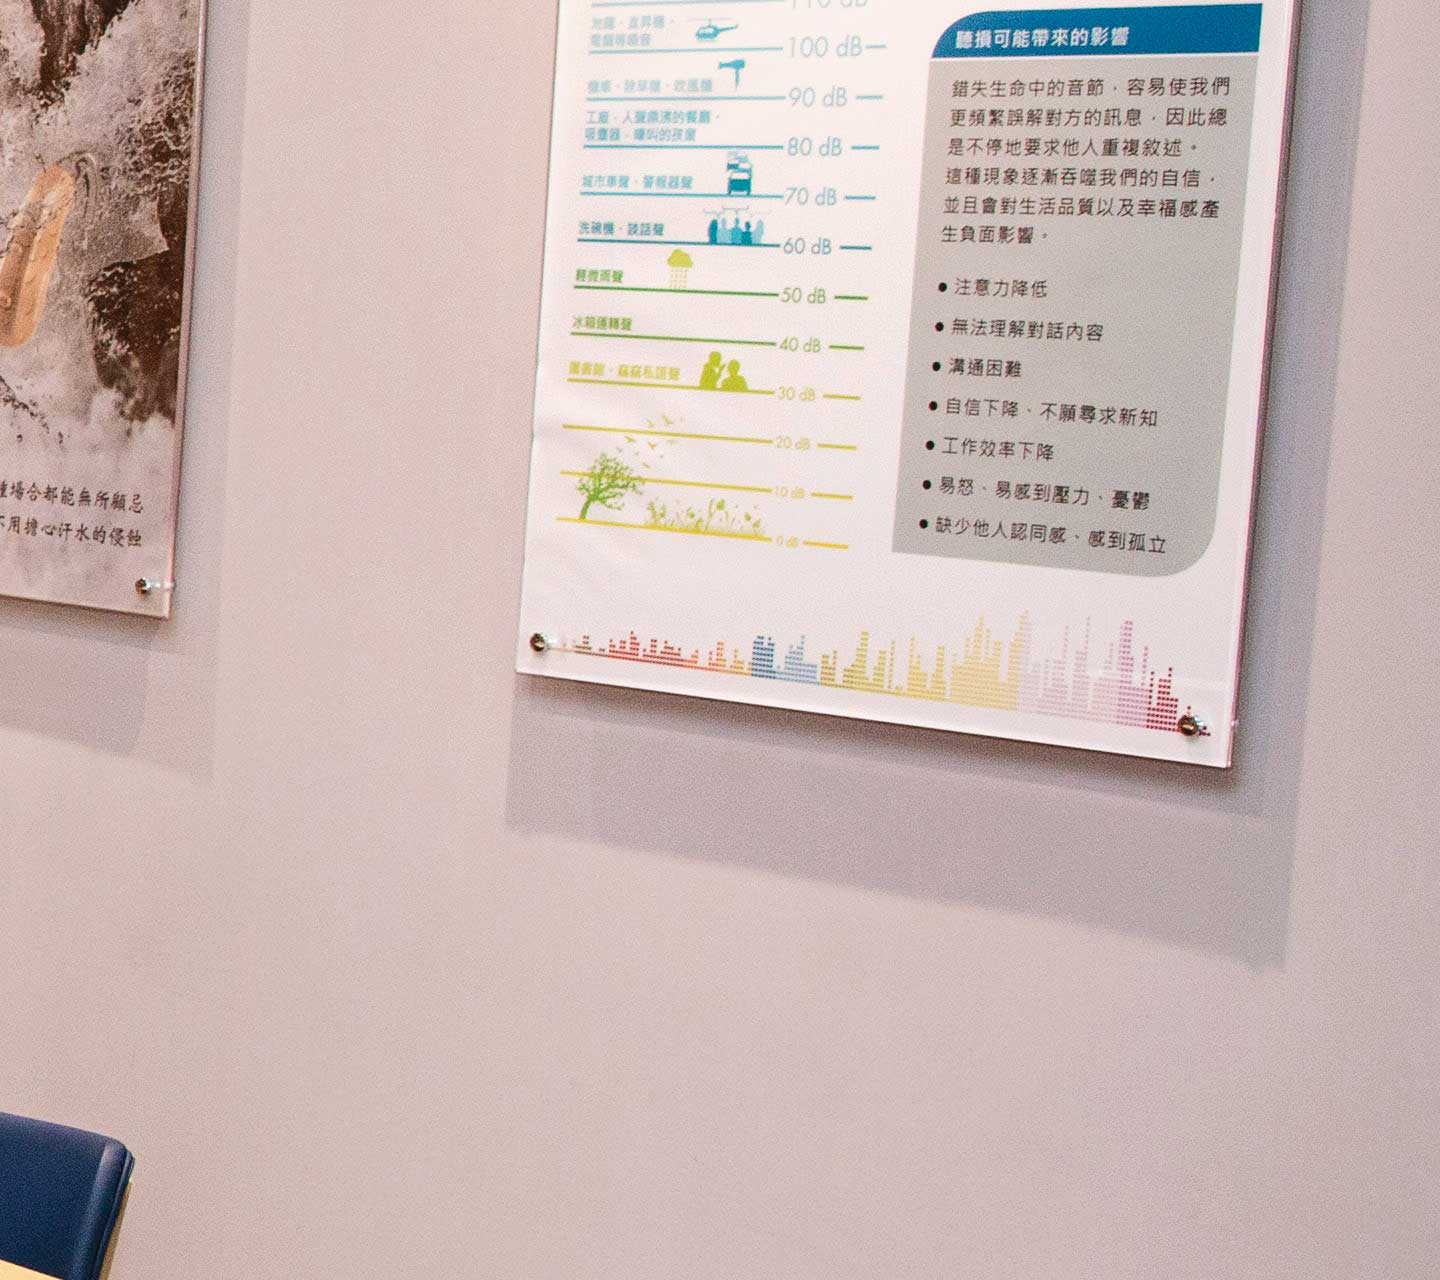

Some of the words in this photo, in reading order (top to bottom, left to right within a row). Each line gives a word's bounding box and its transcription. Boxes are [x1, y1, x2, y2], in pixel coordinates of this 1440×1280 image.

[787, 36, 830, 60] 100
[835, 33, 864, 58] dB
[954, 25, 1131, 50] 聽損可能帶來的影響
[787, 86, 817, 109] 90
[822, 85, 849, 109] dB
[786, 136, 814, 158] 80
[818, 135, 844, 158] dB
[784, 187, 810, 207] 70
[814, 186, 839, 207] dB
[943, 195, 1221, 220] 並且會對生活品質以及幸福感產
[782, 237, 807, 256] 60
[810, 237, 833, 256] dB
[781, 287, 804, 304] 50
[806, 287, 827, 305] dB
[953, 277, 1049, 299] 注意力降低
[950, 317, 1105, 342] 無法理解對話內容
[779, 337, 800, 354] 40
[802, 337, 822, 354] dB
[948, 358, 1023, 379] 溝通困難
[777, 386, 797, 402] 30
[799, 386, 817, 402] dB
[776, 436, 793, 451] 20
[794, 436, 811, 452] dB
[941, 436, 1055, 461] 工作效率下降
